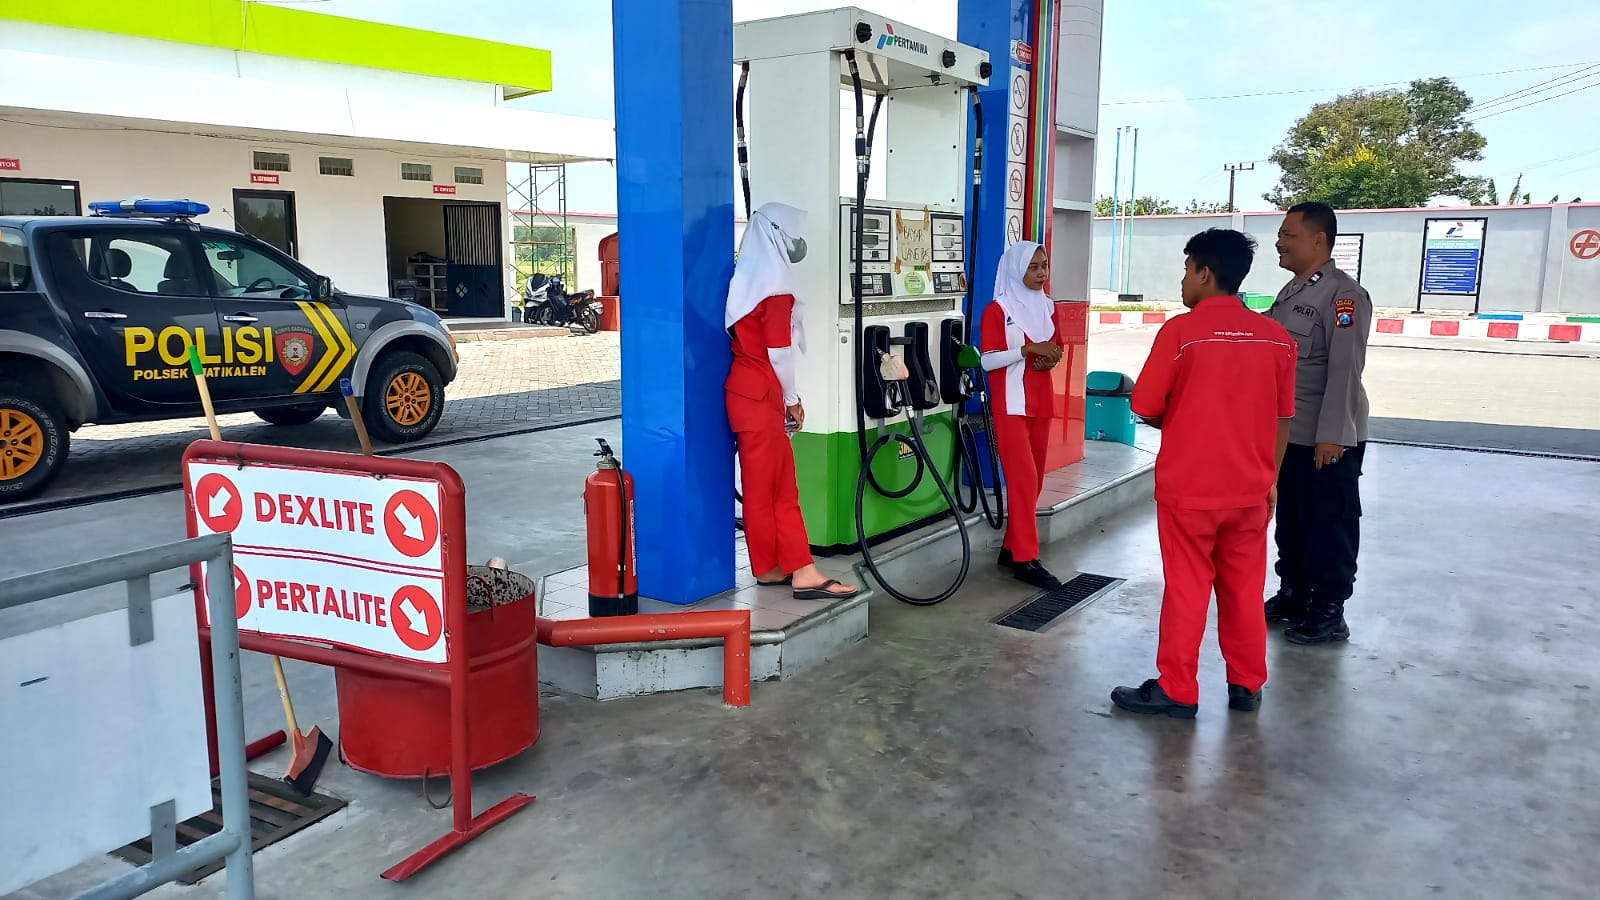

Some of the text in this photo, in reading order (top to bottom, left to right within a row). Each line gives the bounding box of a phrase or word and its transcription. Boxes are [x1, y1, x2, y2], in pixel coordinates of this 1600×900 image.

[1292, 304, 1315, 317] POLRI
[124, 326, 273, 366] POLISI
[133, 367, 189, 381] POLSEK
[254, 492, 375, 535] DEXLITE
[256, 579, 387, 628] PERTALITE
